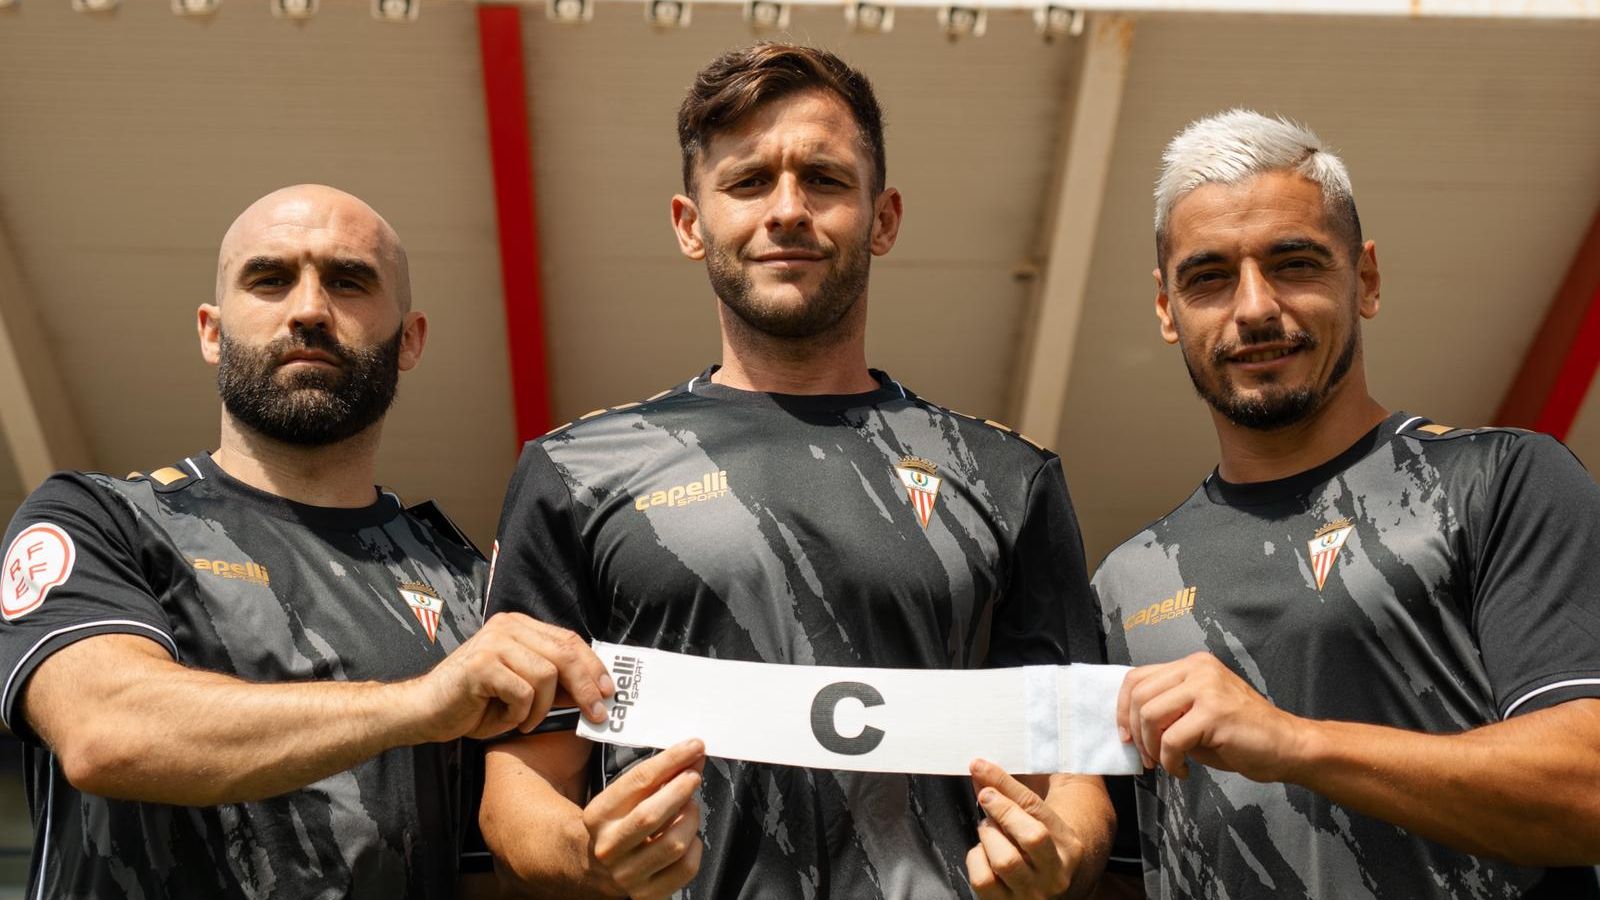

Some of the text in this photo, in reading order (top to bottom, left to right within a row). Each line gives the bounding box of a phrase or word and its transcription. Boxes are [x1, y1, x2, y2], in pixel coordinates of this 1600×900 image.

[635, 470, 727, 511] capelli
[677, 489, 728, 507] SPORT
[1123, 586, 1197, 630] capelli
[609, 655, 636, 733] capelli
[631, 659, 644, 699] SPORT
